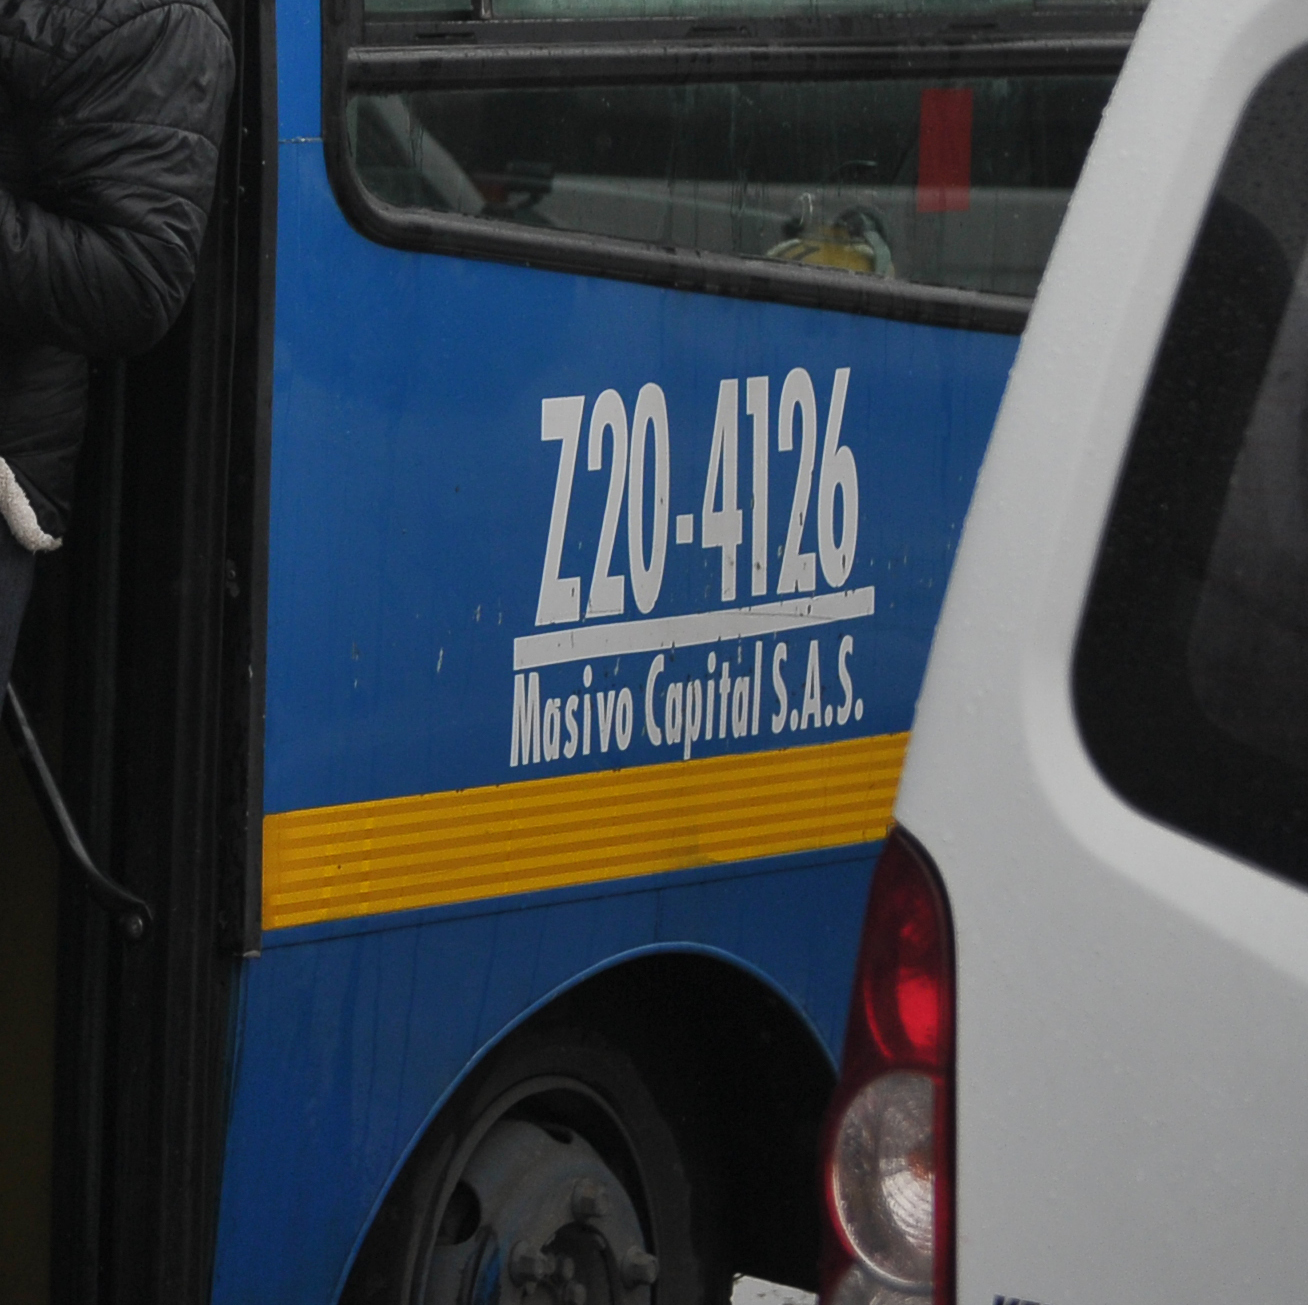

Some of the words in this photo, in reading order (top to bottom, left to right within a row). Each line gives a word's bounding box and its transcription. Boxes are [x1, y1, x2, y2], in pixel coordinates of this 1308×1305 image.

[535, 367, 859, 626] Z20-4126
[510, 665, 633, 767] Masivo
[644, 640, 763, 760] Capital
[771, 635, 864, 734] S.A.S.
